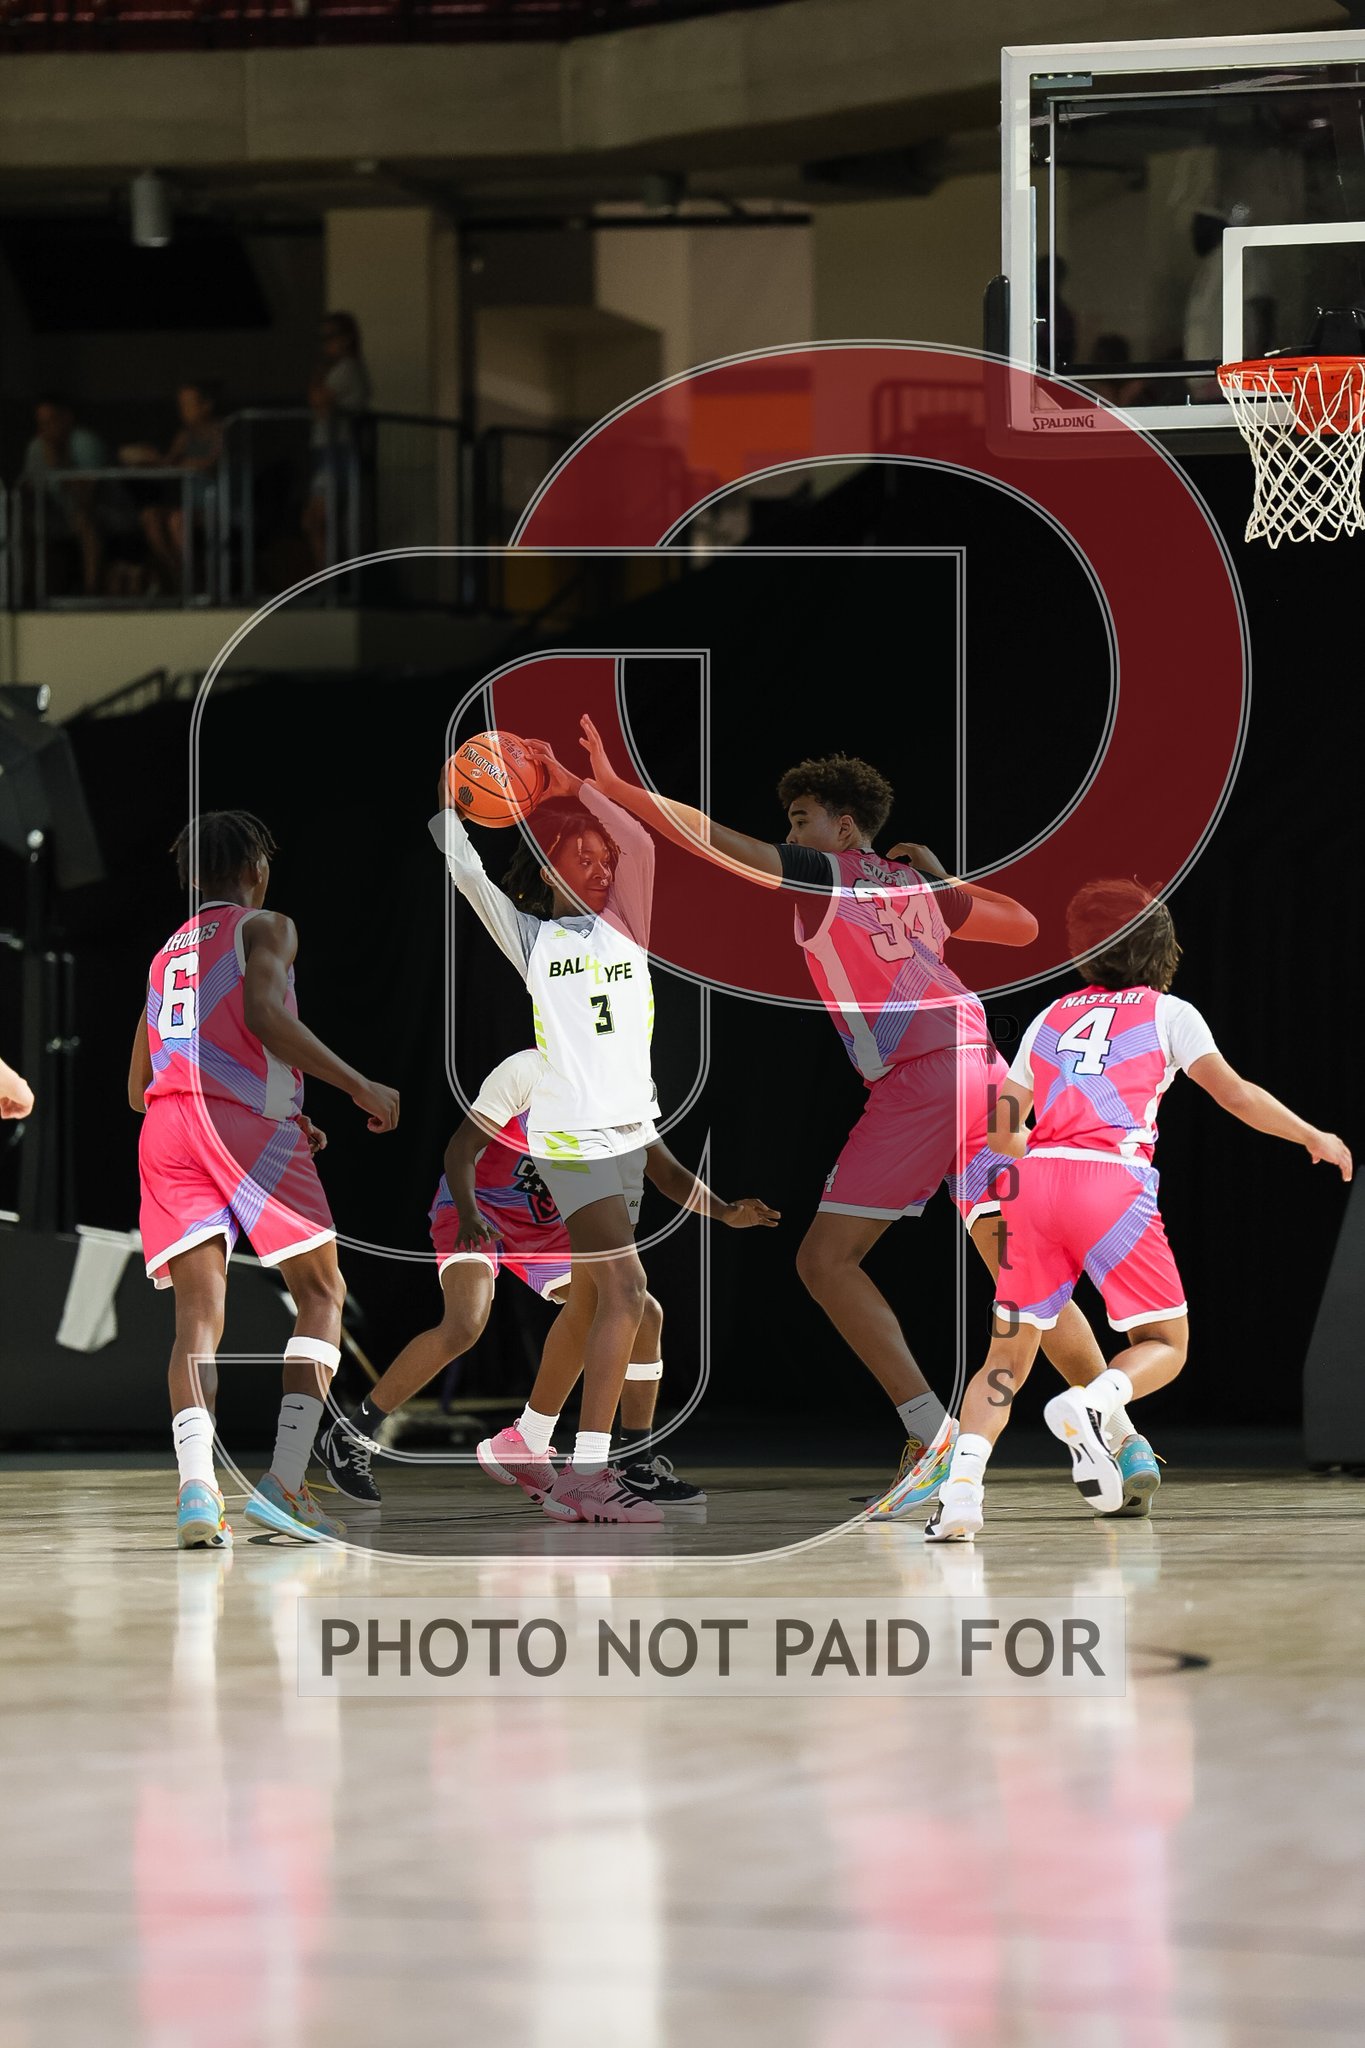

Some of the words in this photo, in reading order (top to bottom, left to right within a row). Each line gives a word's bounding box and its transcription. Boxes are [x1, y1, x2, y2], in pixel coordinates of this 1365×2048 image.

[1032, 415, 1095, 431] SPALDING
[853, 878, 944, 965] 34
[158, 950, 198, 1041] 6
[590, 994, 615, 1036] 3
[1061, 992, 1145, 1009] NASTARI
[1056, 1006, 1117, 1076] 4
